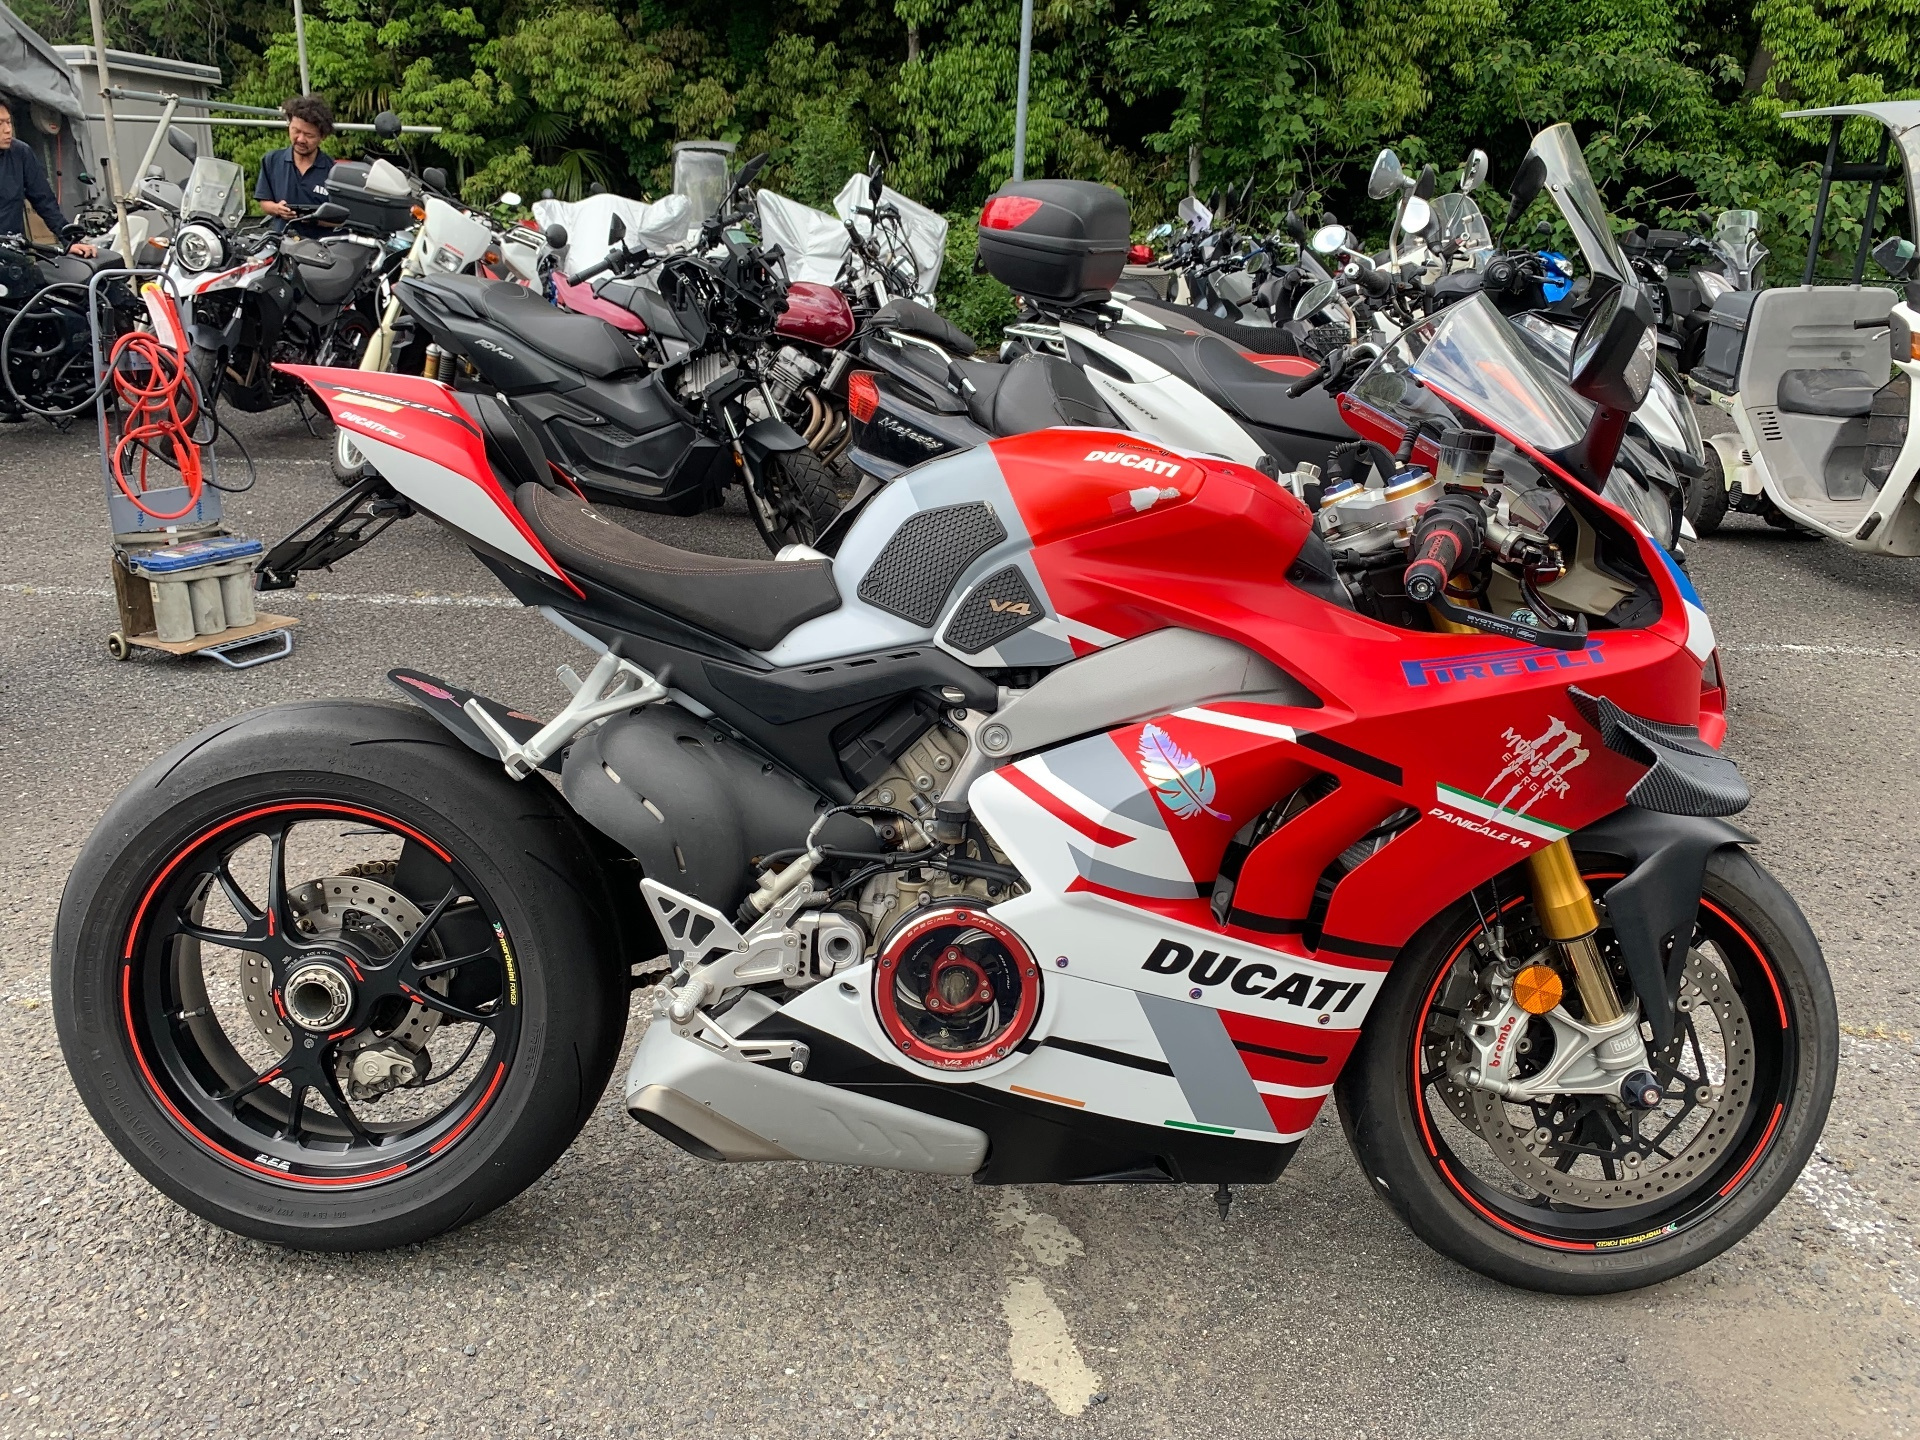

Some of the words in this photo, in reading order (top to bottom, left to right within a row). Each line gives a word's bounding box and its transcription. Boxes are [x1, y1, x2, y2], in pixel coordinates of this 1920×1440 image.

[338, 411, 384, 432] DUCATI
[878, 417, 944, 451] Majesty
[1083, 450, 1181, 478] DUCATI
[990, 599, 1032, 616] V4
[1401, 641, 1605, 687] PIRELLI
[1501, 727, 1571, 800] MONSTER
[1501, 752, 1549, 800] ENERGY
[1428, 807, 1510, 842] PANIGALE
[1510, 834, 1532, 849] V4
[907, 915, 951, 938] SPECIAL
[971, 917, 1007, 937] PARTS
[499, 938, 517, 982] marchesini
[1141, 938, 1366, 1013] DUCATI
[1489, 1016, 1516, 1068] brembo
[1619, 1228, 1661, 1247] marchesini
